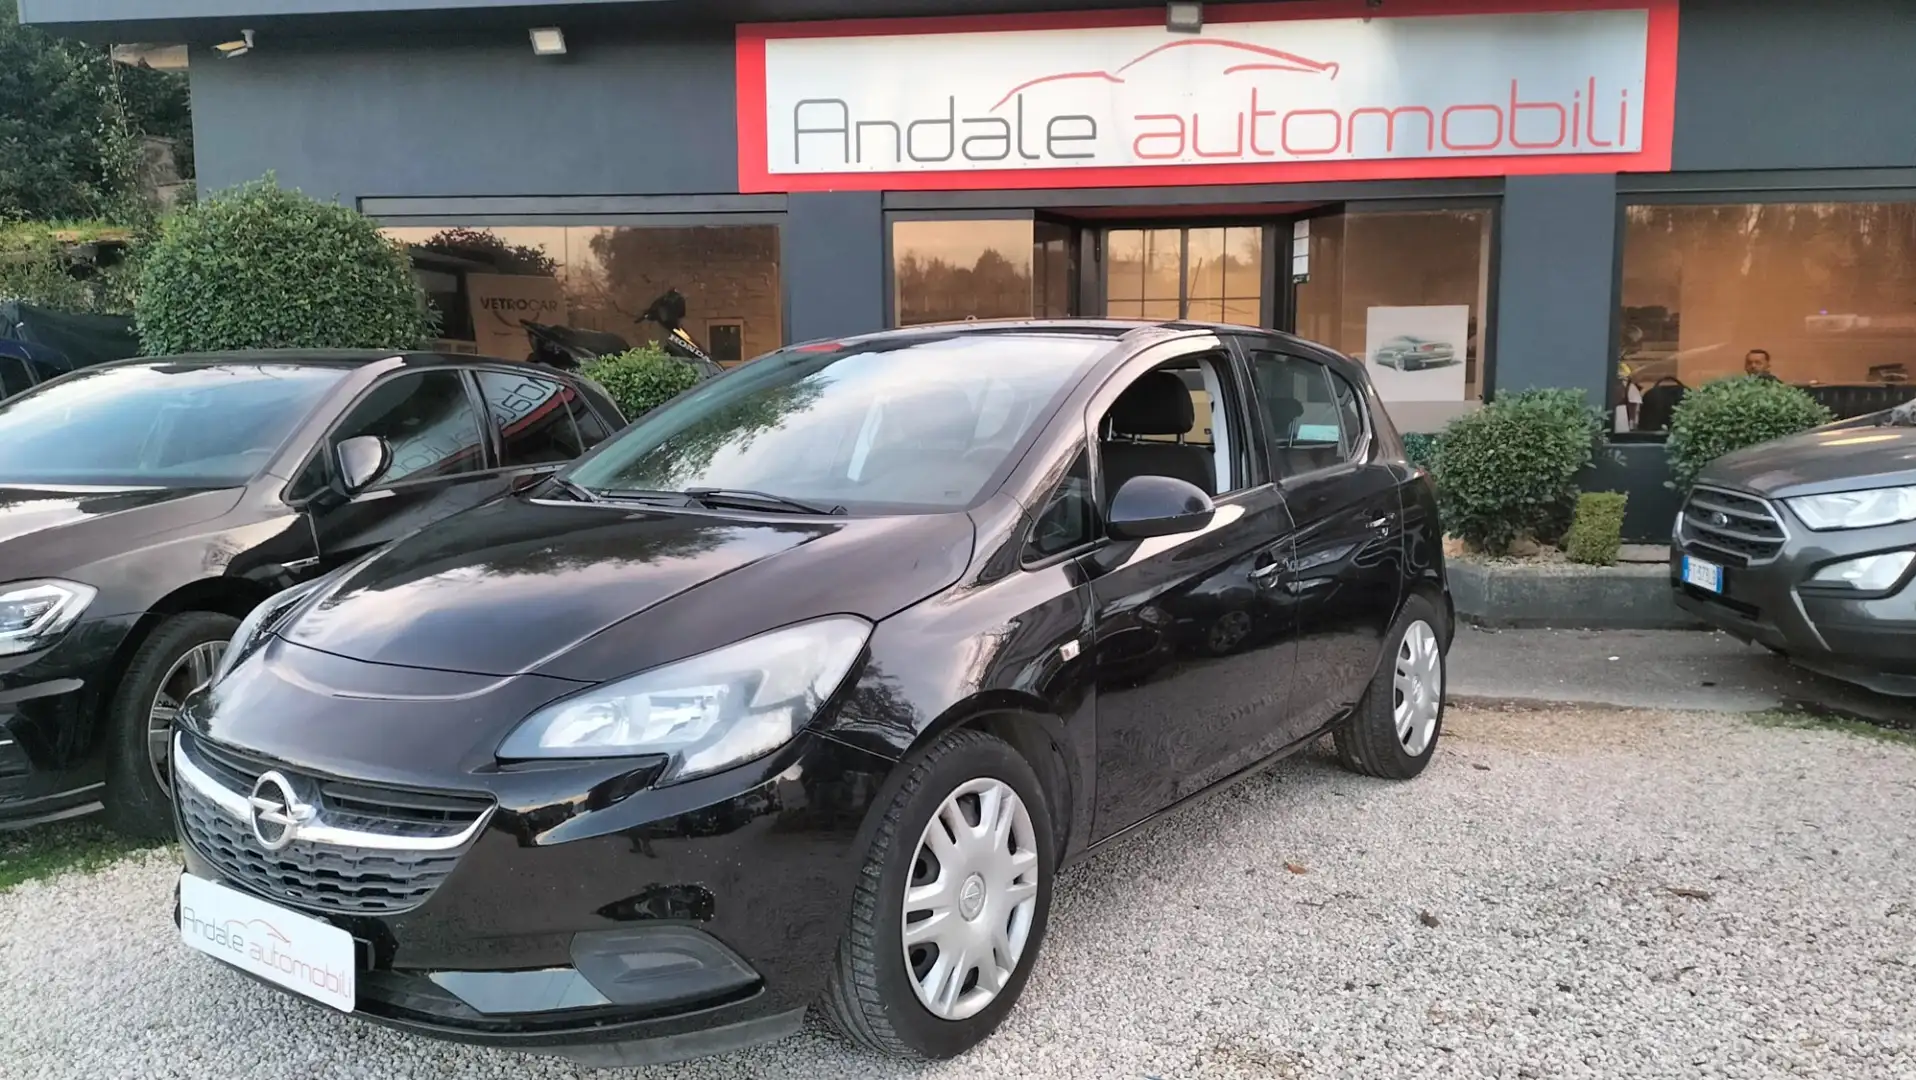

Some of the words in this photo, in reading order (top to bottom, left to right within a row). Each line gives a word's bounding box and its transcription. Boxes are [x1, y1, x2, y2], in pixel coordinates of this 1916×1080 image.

[793, 94, 1097, 165] Andale
[1132, 76, 1629, 160] automobili
[480, 296, 558, 312] VETROCAR
[182, 906, 244, 953] Andale
[249, 941, 352, 999] automobili
